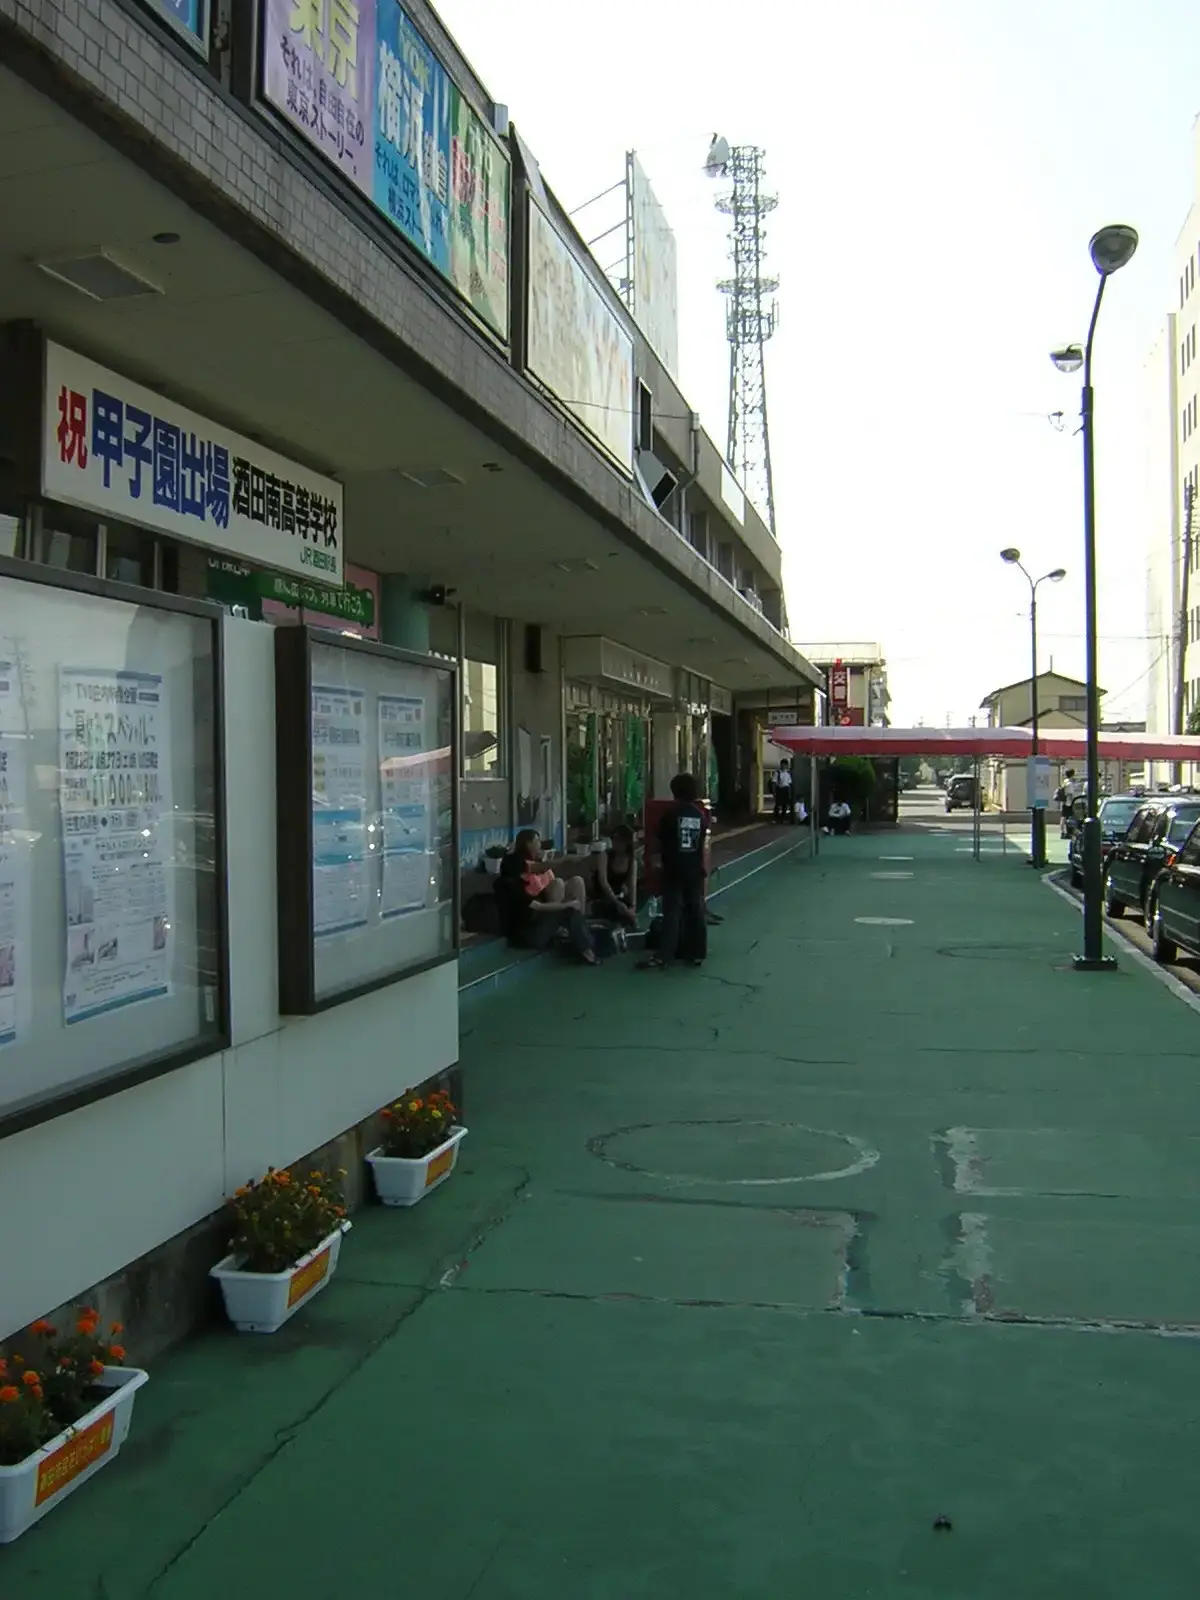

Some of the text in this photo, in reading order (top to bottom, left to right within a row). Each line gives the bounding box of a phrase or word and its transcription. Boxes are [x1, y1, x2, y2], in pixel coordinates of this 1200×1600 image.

[57, 386, 337, 548] 祝 甲子園出場 酒田南高等学校
